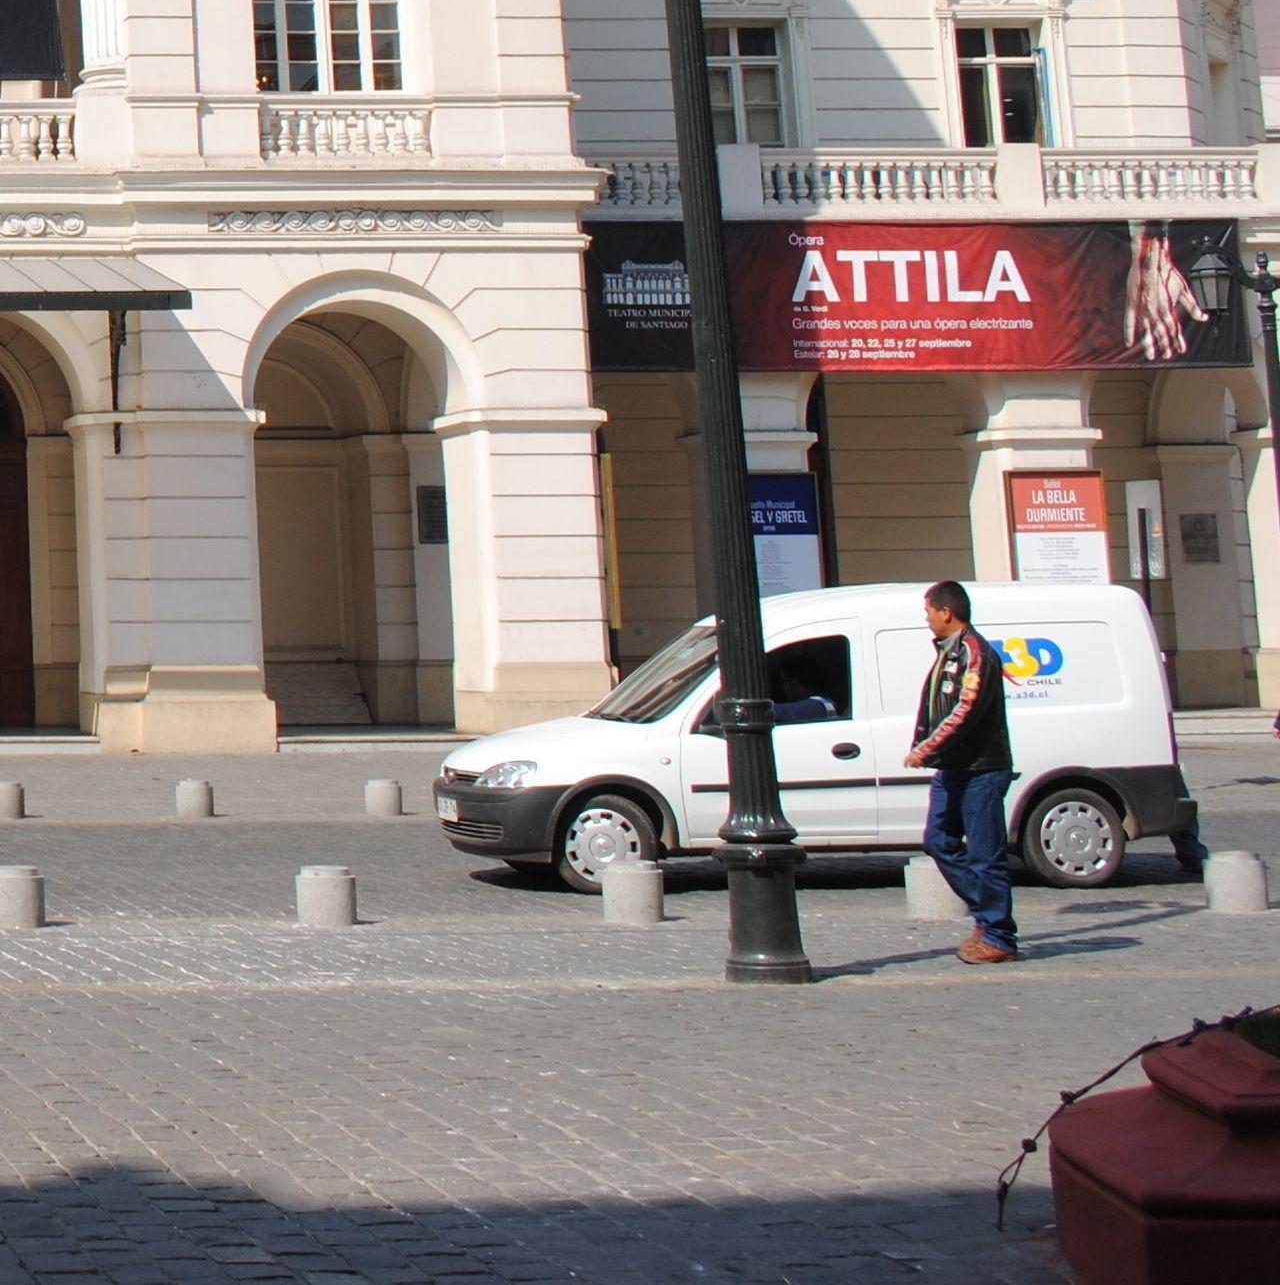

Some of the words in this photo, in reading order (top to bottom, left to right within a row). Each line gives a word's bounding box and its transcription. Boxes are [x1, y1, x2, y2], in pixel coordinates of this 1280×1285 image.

[788, 231, 825, 247] Ópera
[792, 250, 1032, 302] ATTILA
[608, 308, 647, 317] TEATRO
[649, 308, 692, 317] MUNICIP
[625, 321, 639, 329] DE
[641, 321, 688, 329] SANTIAGO
[792, 317, 841, 329] Grandes
[843, 319, 878, 329] voces
[880, 319, 907, 331] para
[909, 319, 932, 329] una
[934, 317, 967, 331] ópera
[969, 317, 1034, 329] electrizante
[897, 341, 904, 349] y
[919, 338, 972, 349] septiembre
[840, 351, 847, 360] y
[862, 349, 915, 360] septiembre
[1032, 490, 1044, 504] LA
[1046, 490, 1077, 504] BELLA
[775, 510, 807, 523] GRETEL
[1026, 508, 1086, 522] DURMIENTE
[1027, 678, 1062, 686] CHILE
